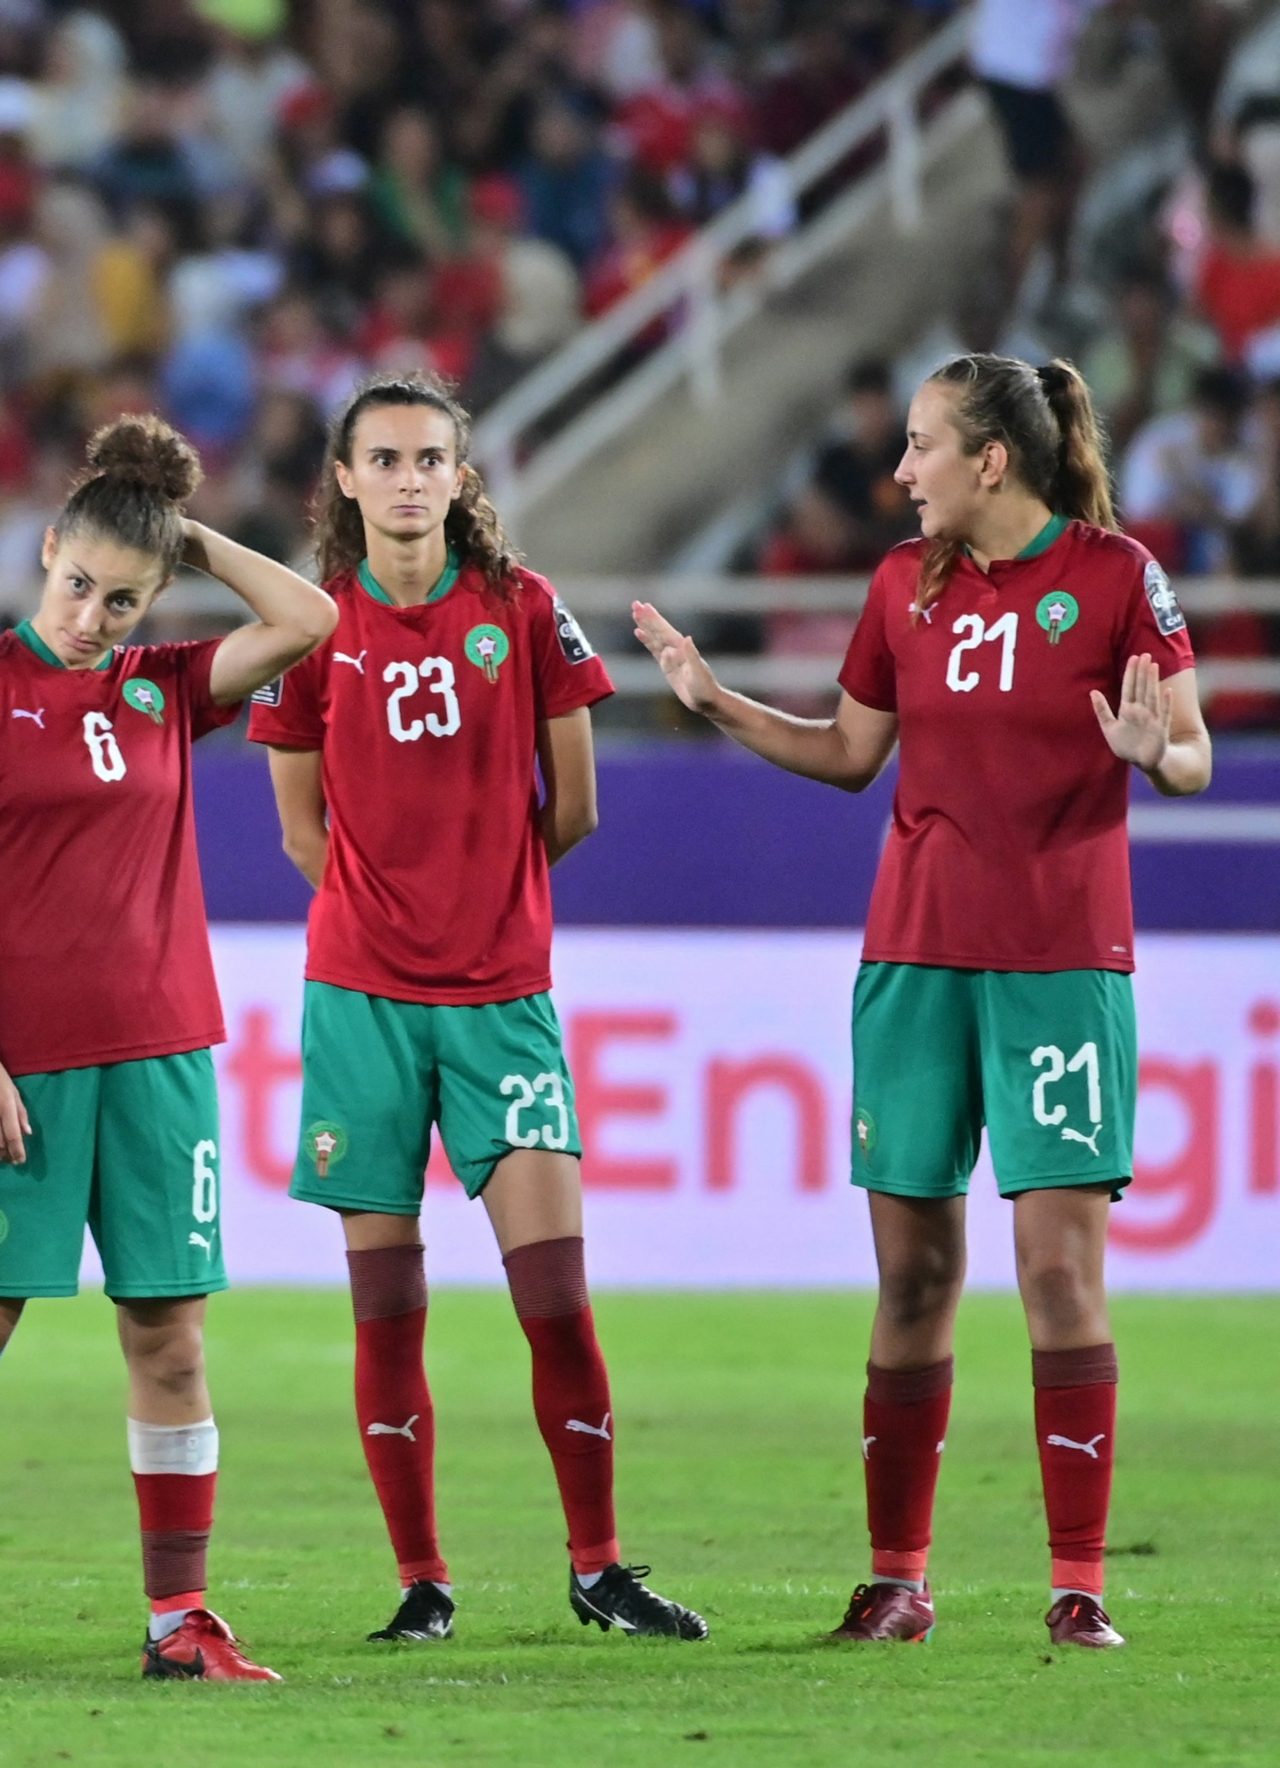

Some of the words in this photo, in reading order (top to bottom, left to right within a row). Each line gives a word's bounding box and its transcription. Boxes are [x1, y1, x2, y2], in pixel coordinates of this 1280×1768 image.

[946, 612, 1019, 693] 21
[382, 655, 461, 742] 23
[82, 711, 127, 782] 6
[499, 1071, 569, 1149] 23
[1030, 1041, 1102, 1126] 21
[192, 1139, 218, 1224] 6
